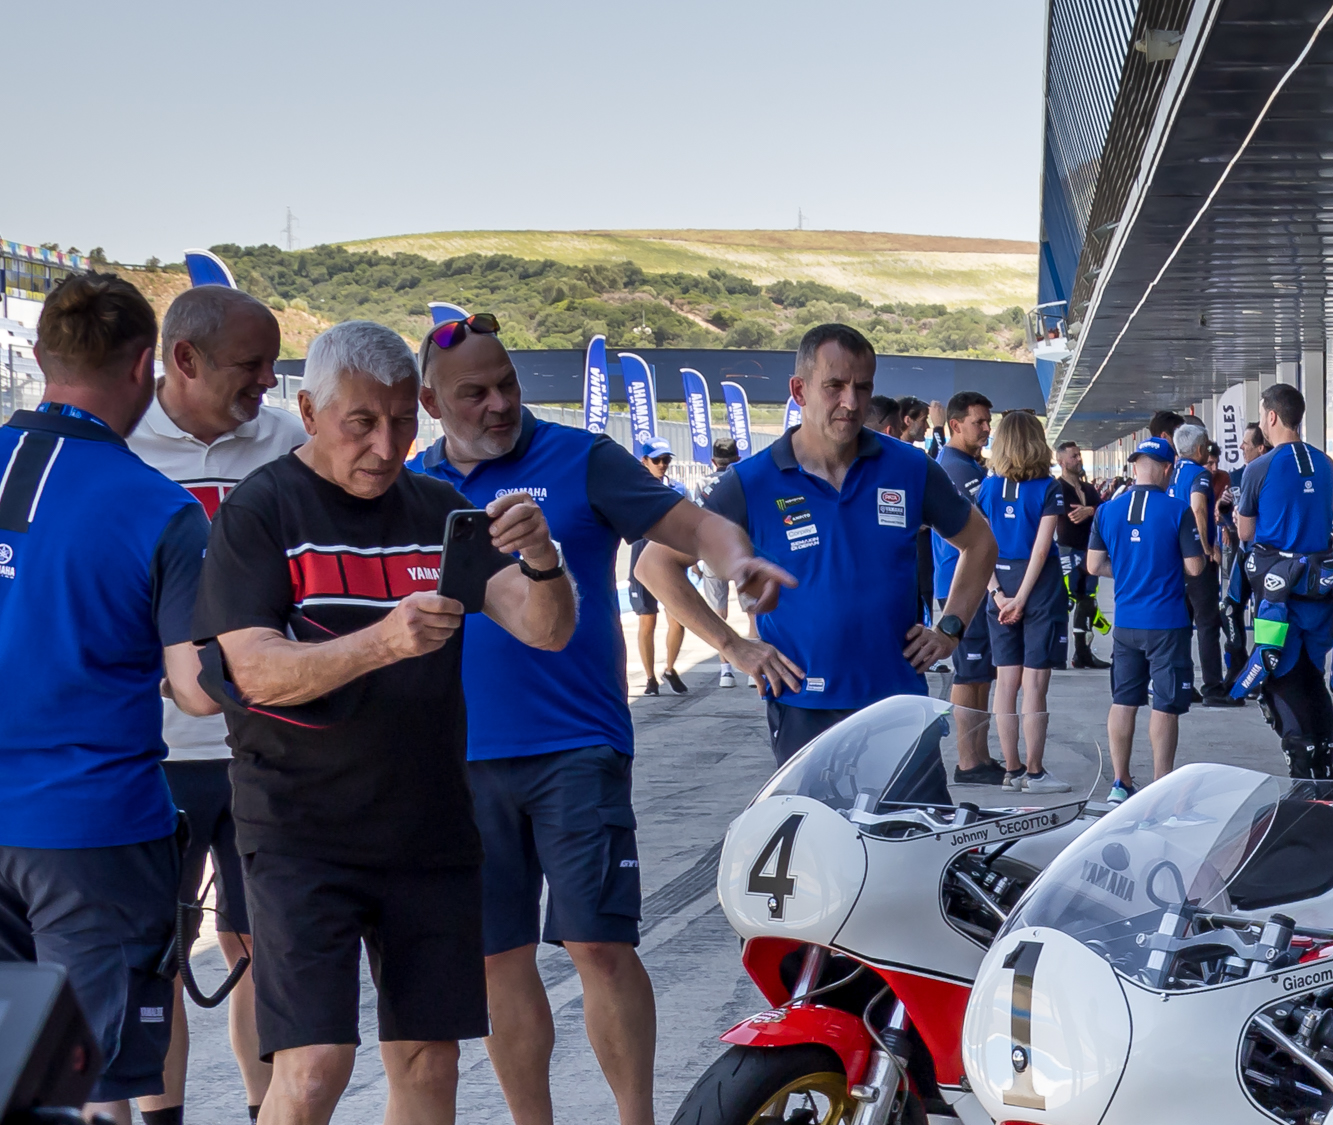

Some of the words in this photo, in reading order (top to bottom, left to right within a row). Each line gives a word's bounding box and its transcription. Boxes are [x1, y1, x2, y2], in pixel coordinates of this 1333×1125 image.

[1223, 404, 1240, 464] GILLES
[407, 566, 441, 581] YAMA
[950, 827, 989, 848] Johnny
[999, 814, 1049, 836] CECOTTO
[745, 811, 808, 922] 4
[1001, 940, 1047, 1111] 1
